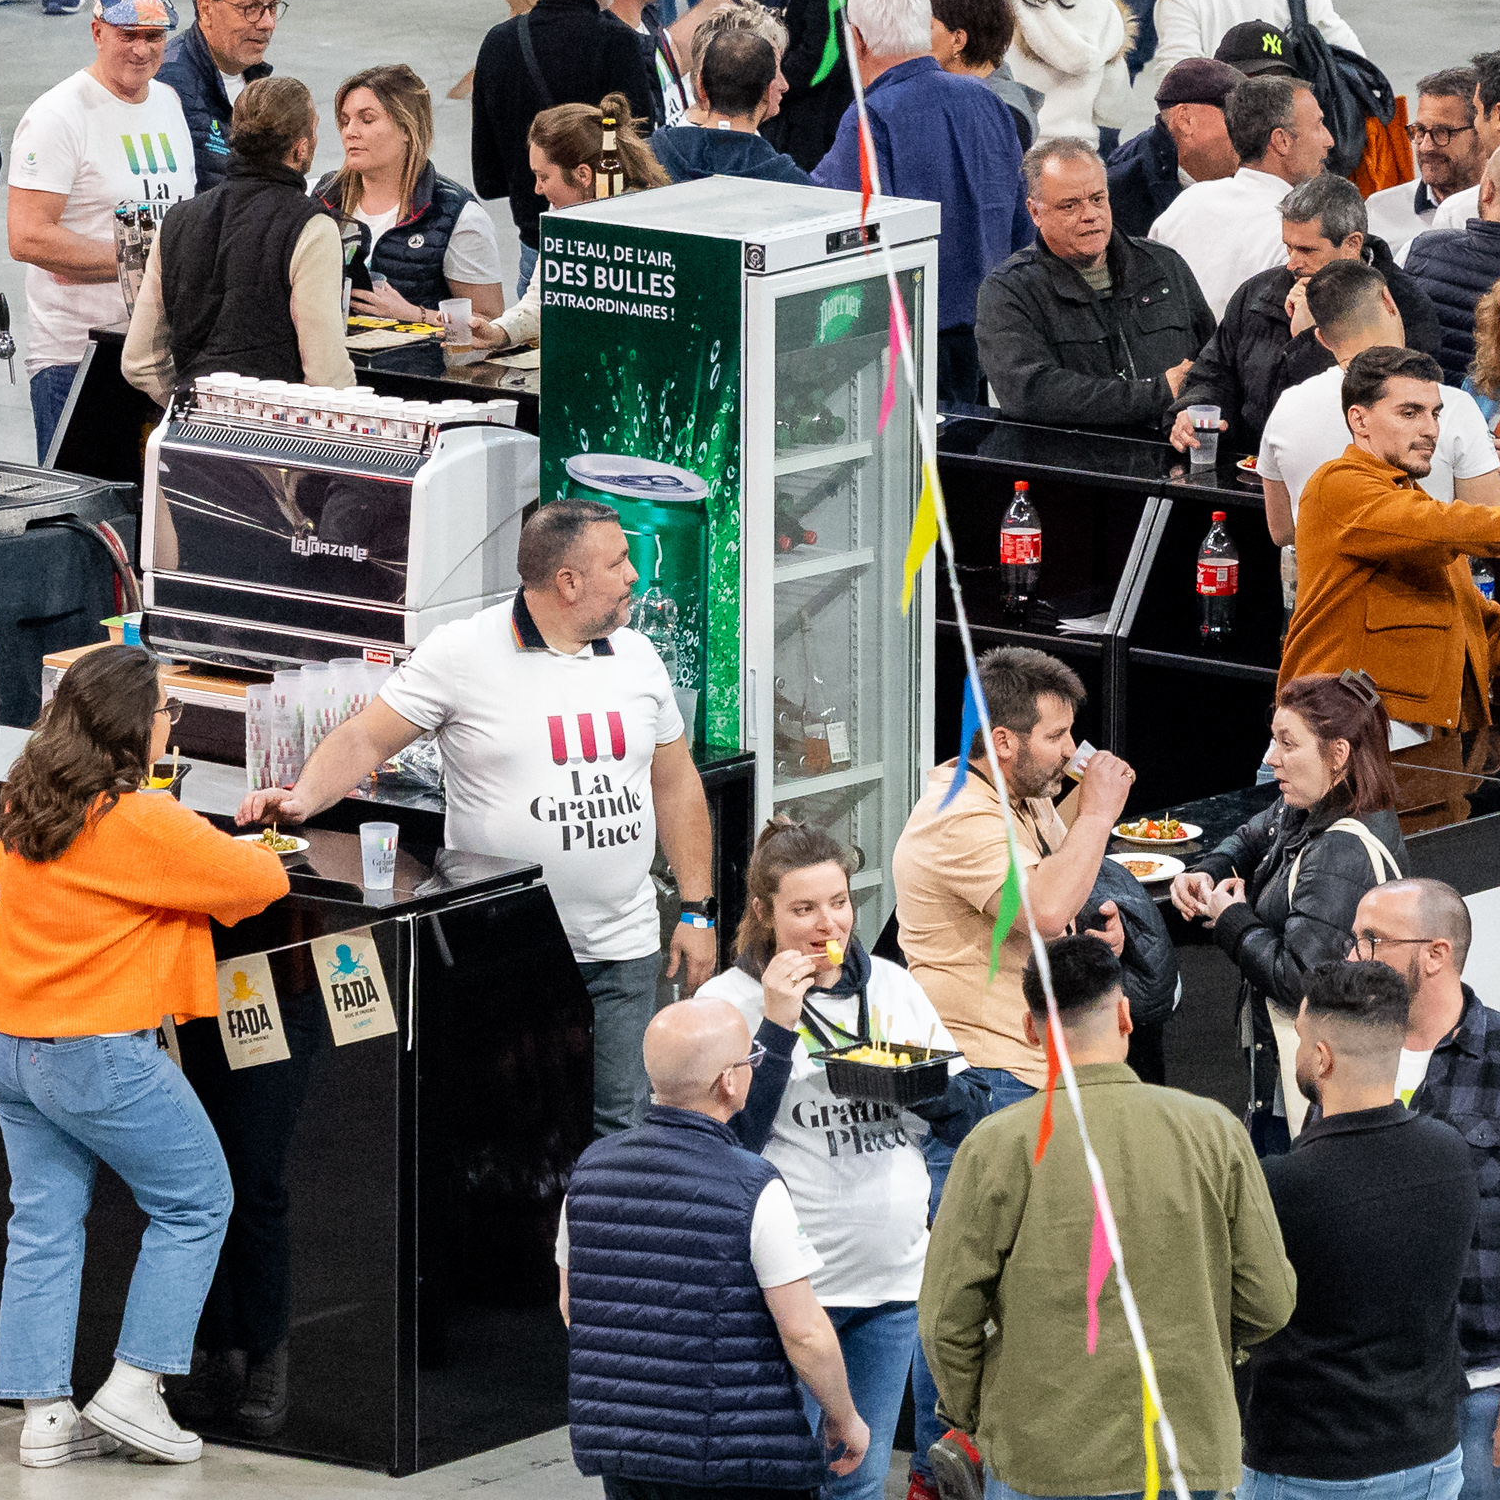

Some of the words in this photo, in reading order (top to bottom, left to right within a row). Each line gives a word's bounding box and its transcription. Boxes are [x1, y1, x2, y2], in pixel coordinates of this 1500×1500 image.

[143, 178, 170, 200] La
[544, 236, 564, 254] DE
[567, 239, 611, 263] L'EAU,
[613, 245, 634, 263] DE
[637, 248, 677, 272] L'AIR,
[544, 259, 588, 287] DES
[593, 265, 676, 299] BULLES
[544, 291, 668, 320] EXTRAORDINAIRES
[571, 770, 613, 796] La
[529, 785, 642, 822] Grande
[562, 820, 642, 851] Place
[331, 975, 381, 1012] FADA
[226, 1003, 274, 1039] FADA
